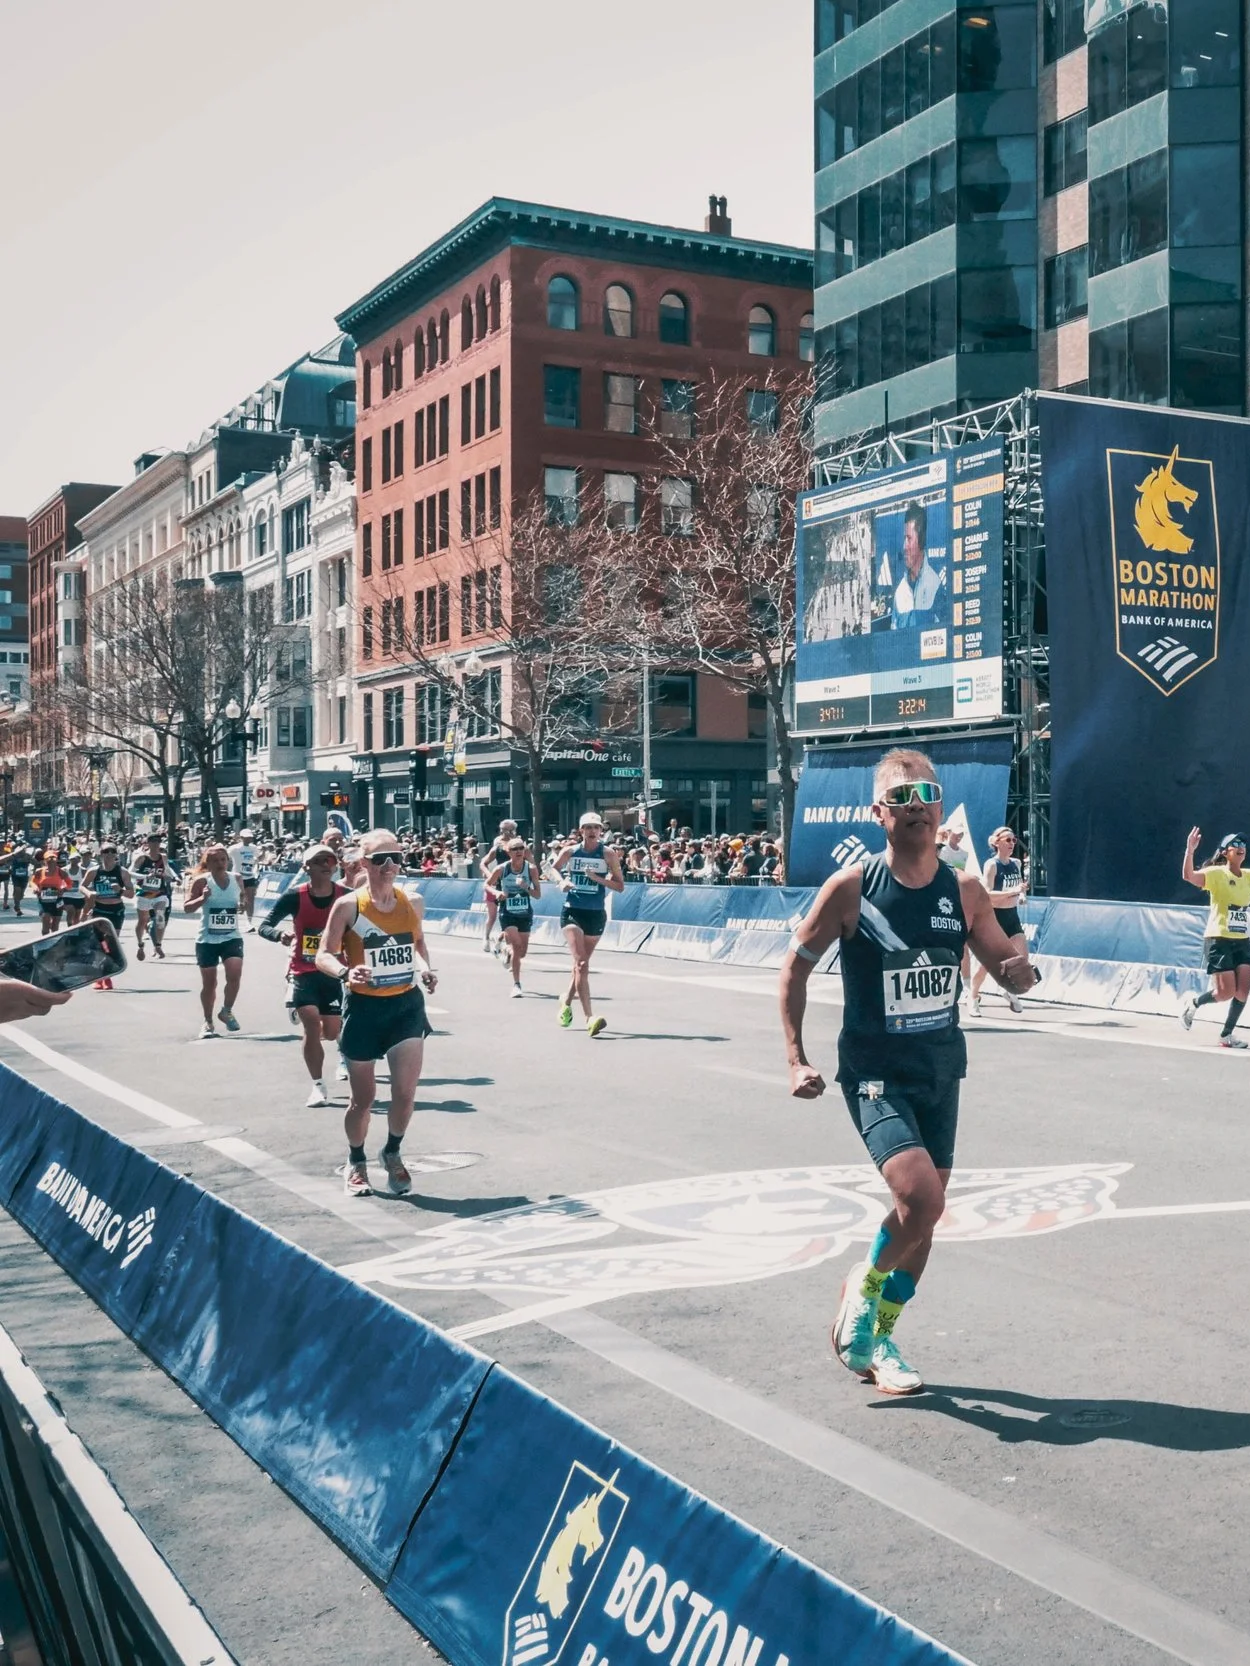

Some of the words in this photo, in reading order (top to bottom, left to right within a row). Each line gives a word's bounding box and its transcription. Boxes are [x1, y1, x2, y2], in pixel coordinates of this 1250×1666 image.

[965, 532, 989, 544] CHARLIE
[1119, 560, 1215, 589] BOSTON
[1120, 588, 1215, 611] MARATHON
[1121, 615, 1152, 625] BANK
[1153, 617, 1165, 626] OF
[1167, 618, 1213, 630] AMERICA
[903, 676, 917, 684] Wave
[612, 753, 632, 762] café
[256, 788, 275, 798] DD
[803, 807, 833, 823] BANK
[835, 806, 852, 823] OF
[211, 915, 236, 925] 15975
[930, 916, 962, 931] BOSTON
[306, 937, 320, 949] 29
[369, 946, 413, 967] 14683
[891, 967, 953, 1000] 14082
[603, 1546, 765, 1666] BOSTON
